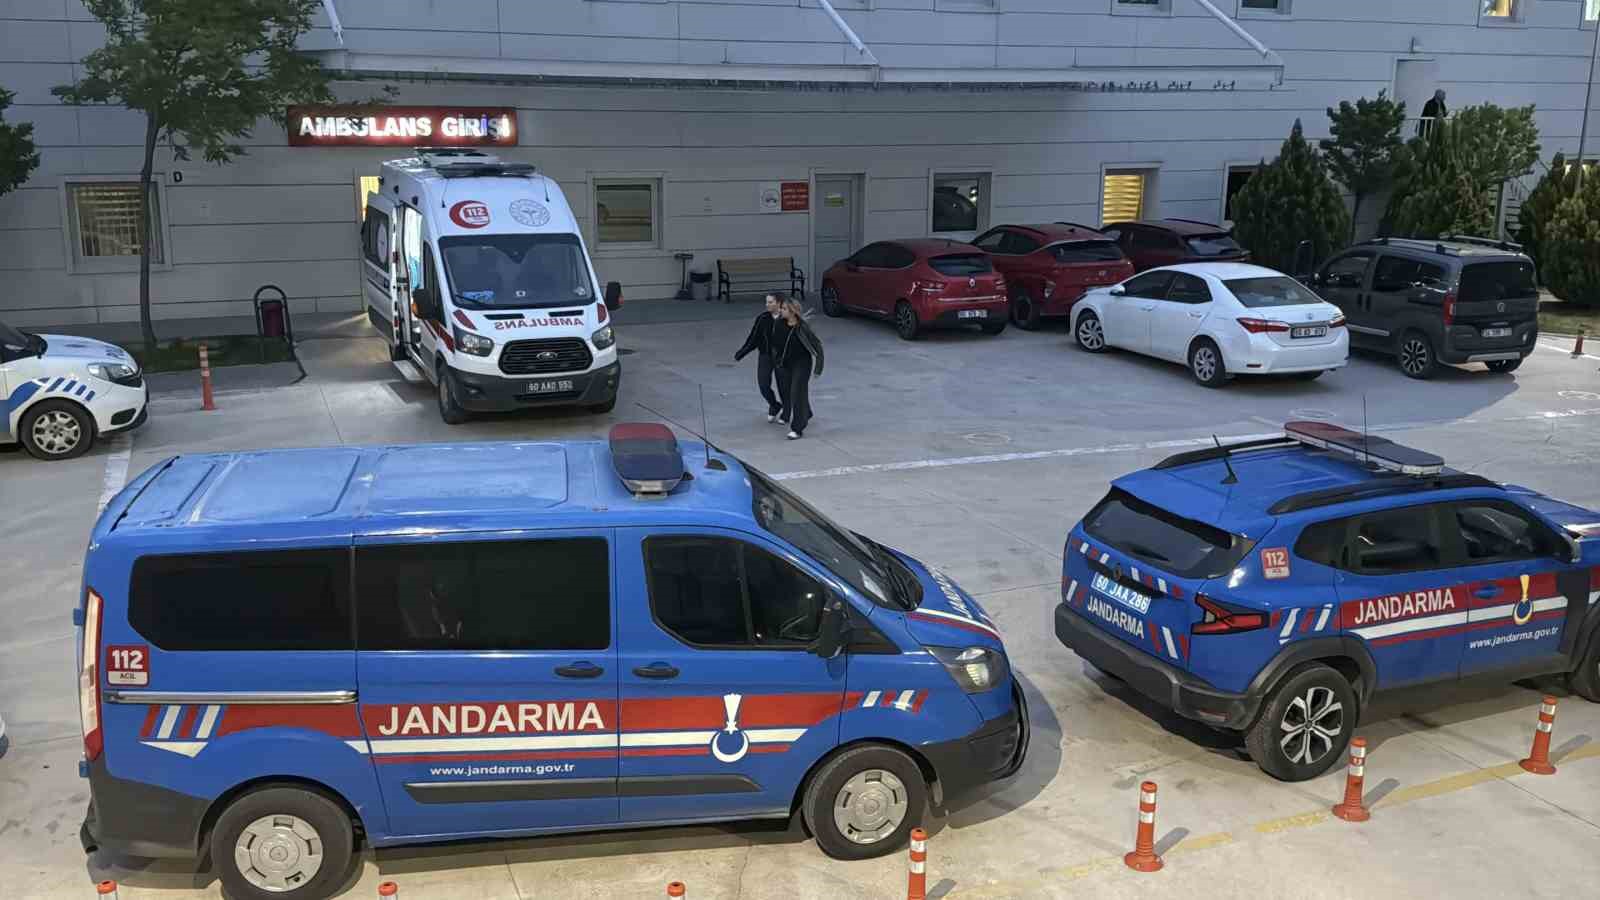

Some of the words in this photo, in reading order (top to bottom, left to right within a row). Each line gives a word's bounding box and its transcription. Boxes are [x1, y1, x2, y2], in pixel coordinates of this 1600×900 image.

[300, 115, 432, 137] AMBULANS
[173, 171, 183, 182] D
[467, 207, 485, 216] 112
[1264, 551, 1286, 567] 112
[1096, 575, 1109, 590] 60
[1109, 583, 1130, 601] JAA
[1129, 592, 1149, 611] 286
[1087, 595, 1145, 640] JANDARMA
[1354, 589, 1455, 624] JANDARMA
[1469, 626, 1559, 649] www.jandarma.gov.tr
[112, 649, 144, 670] 112
[378, 702, 605, 736] JANDARMA
[430, 763, 575, 776] www.jandarma.gov.tr
